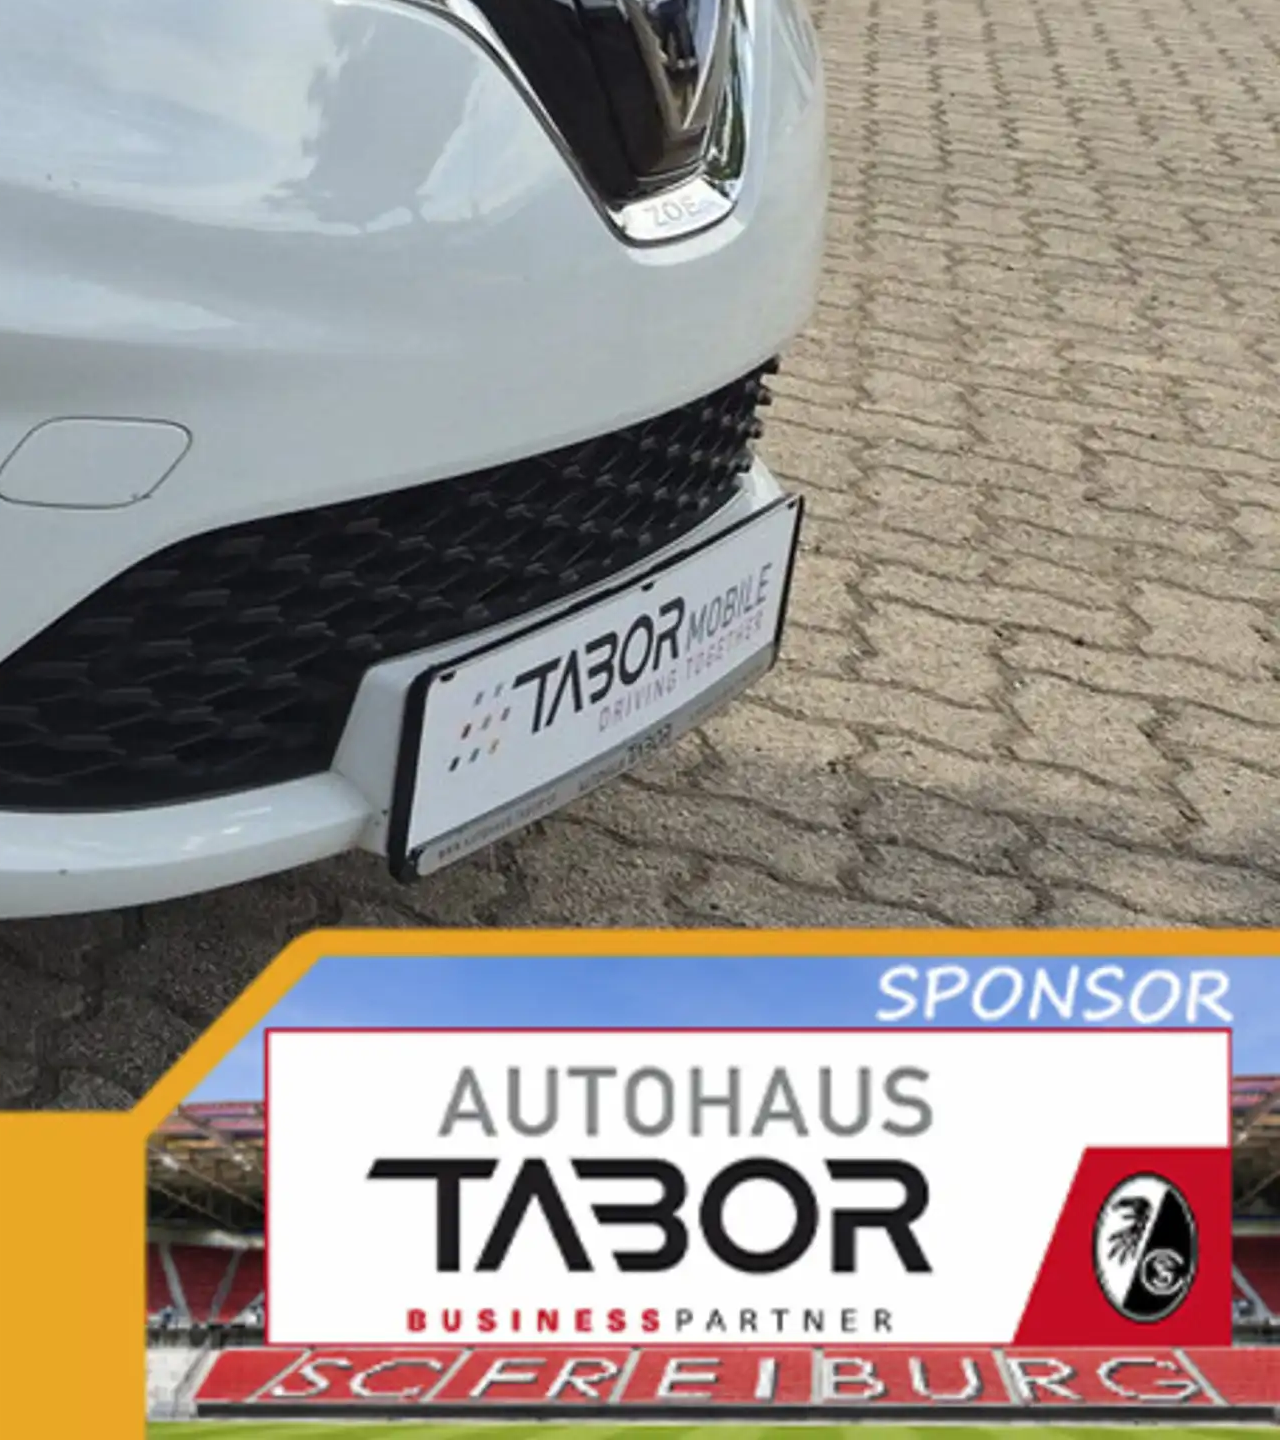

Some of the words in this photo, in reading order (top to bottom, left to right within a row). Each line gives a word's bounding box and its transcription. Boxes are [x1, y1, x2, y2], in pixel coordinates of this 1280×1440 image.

[512, 596, 685, 734] TABOR
[597, 669, 677, 733] DRIVING
[685, 611, 764, 681] TOGETHER
